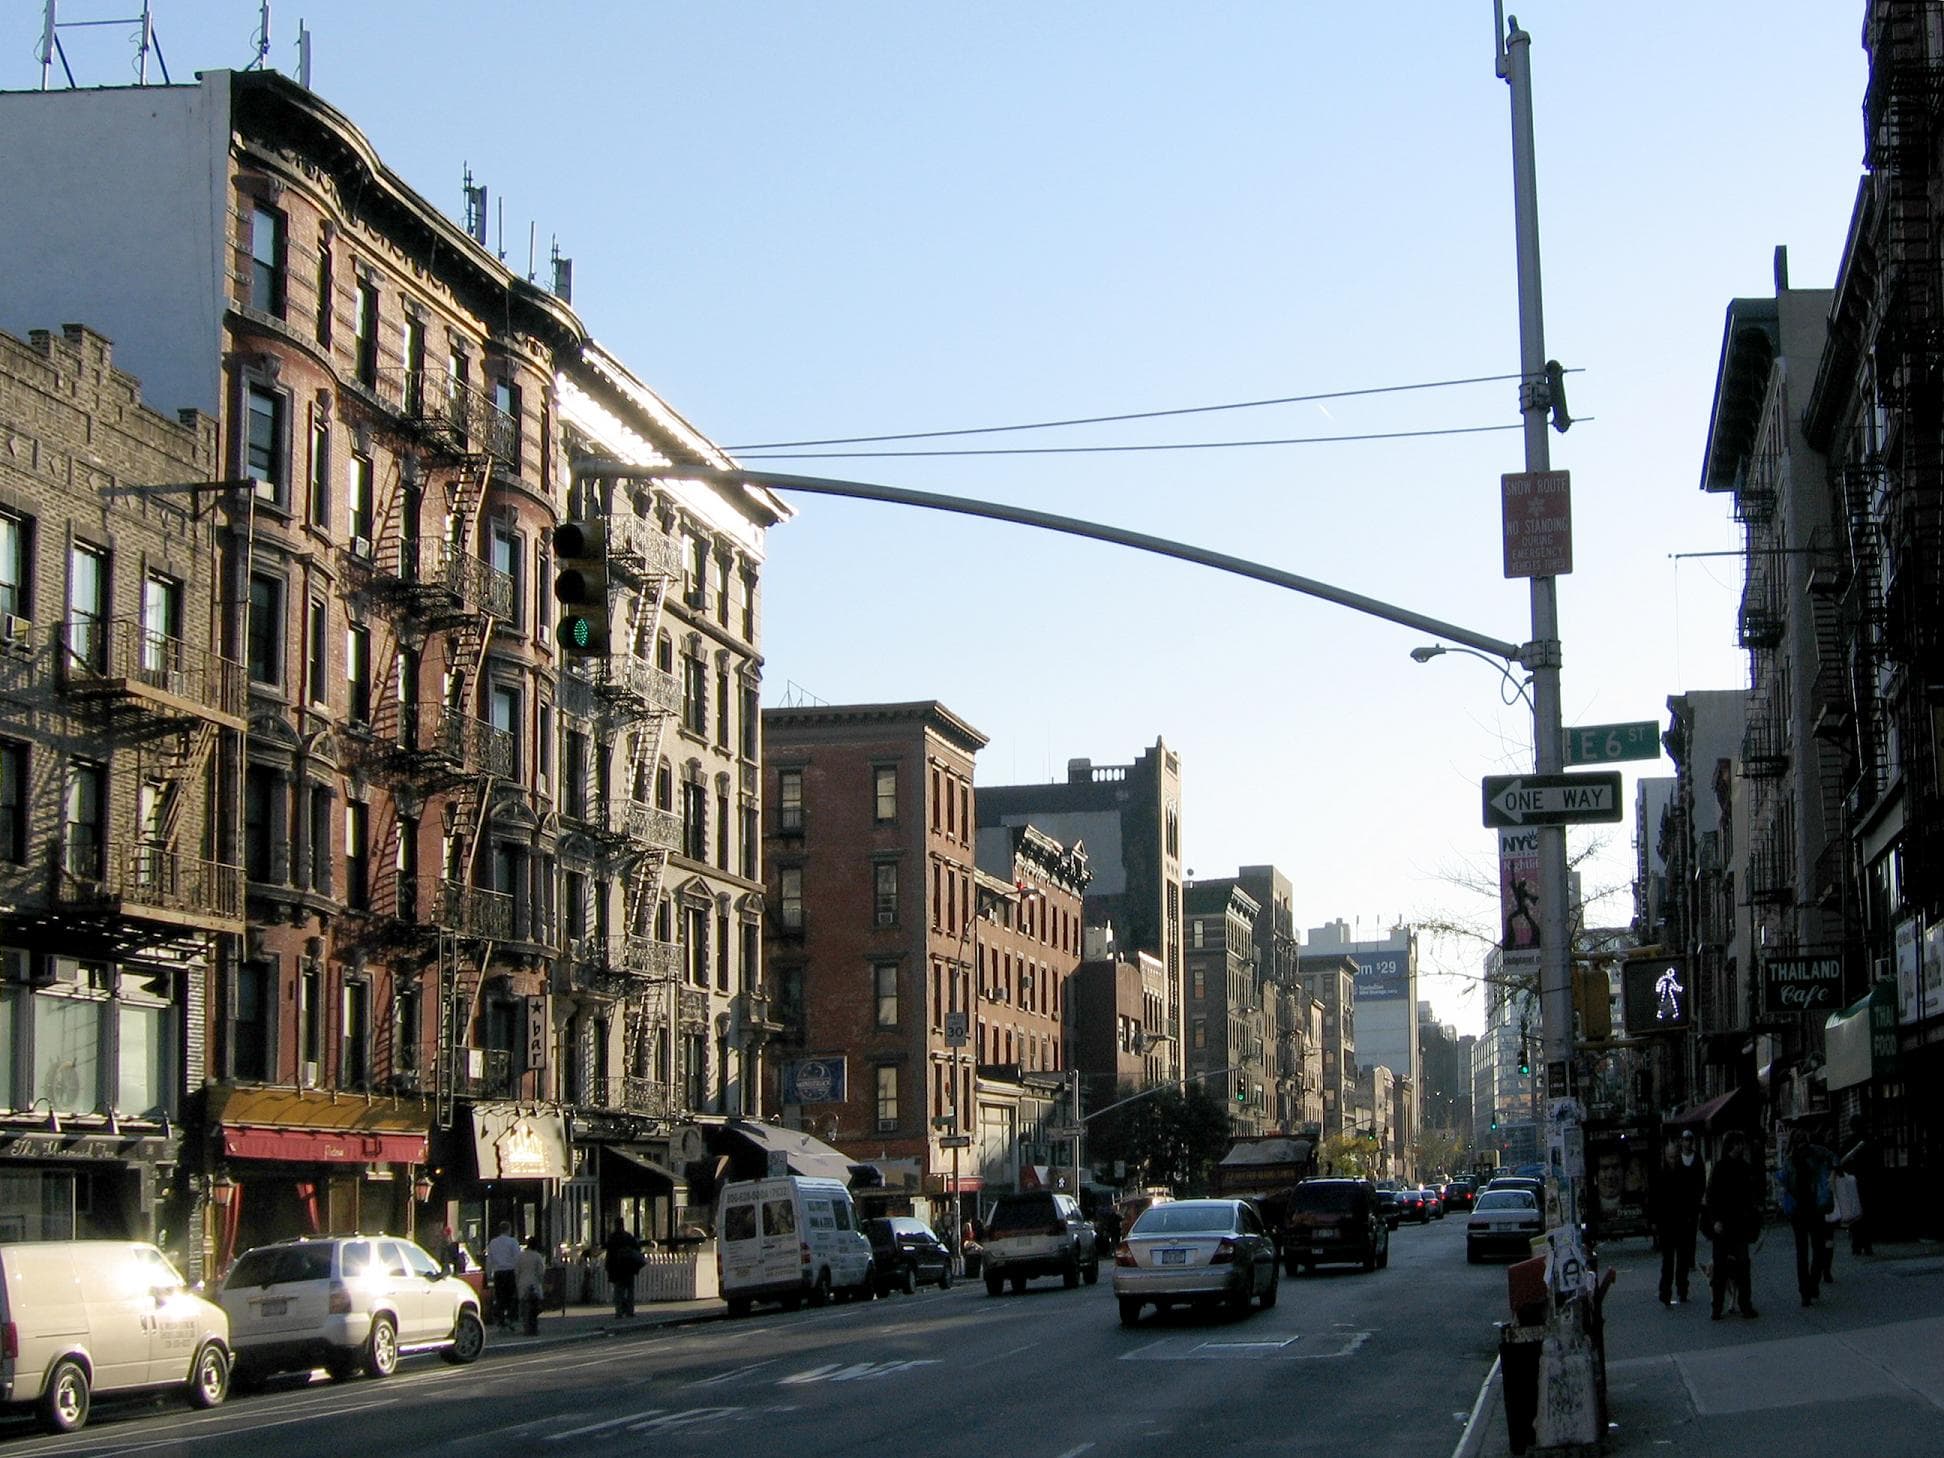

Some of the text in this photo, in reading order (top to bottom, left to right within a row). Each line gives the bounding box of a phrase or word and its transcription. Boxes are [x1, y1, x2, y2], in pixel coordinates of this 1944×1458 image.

[1506, 478, 1568, 497] SNOW ROUTE
[1507, 517, 1569, 536] NO STANDING
[1522, 533, 1553, 547] DURING
[1512, 545, 1563, 561] EMERGENCY
[1581, 727, 1646, 760] E 6 ST
[1505, 788, 1604, 812] ONE WAY
[1503, 836, 1538, 852] NYC
[1376, 960, 1397, 974] $29
[1768, 959, 1840, 982] THAILAND
[1874, 1006, 1895, 1027] THAI
[947, 1026, 963, 1037] 30
[531, 1020, 542, 1067] bar
[1874, 1035, 1897, 1056] FOOD
[10, 1138, 38, 1157] The
[43, 1140, 94, 1159] Mermaid
